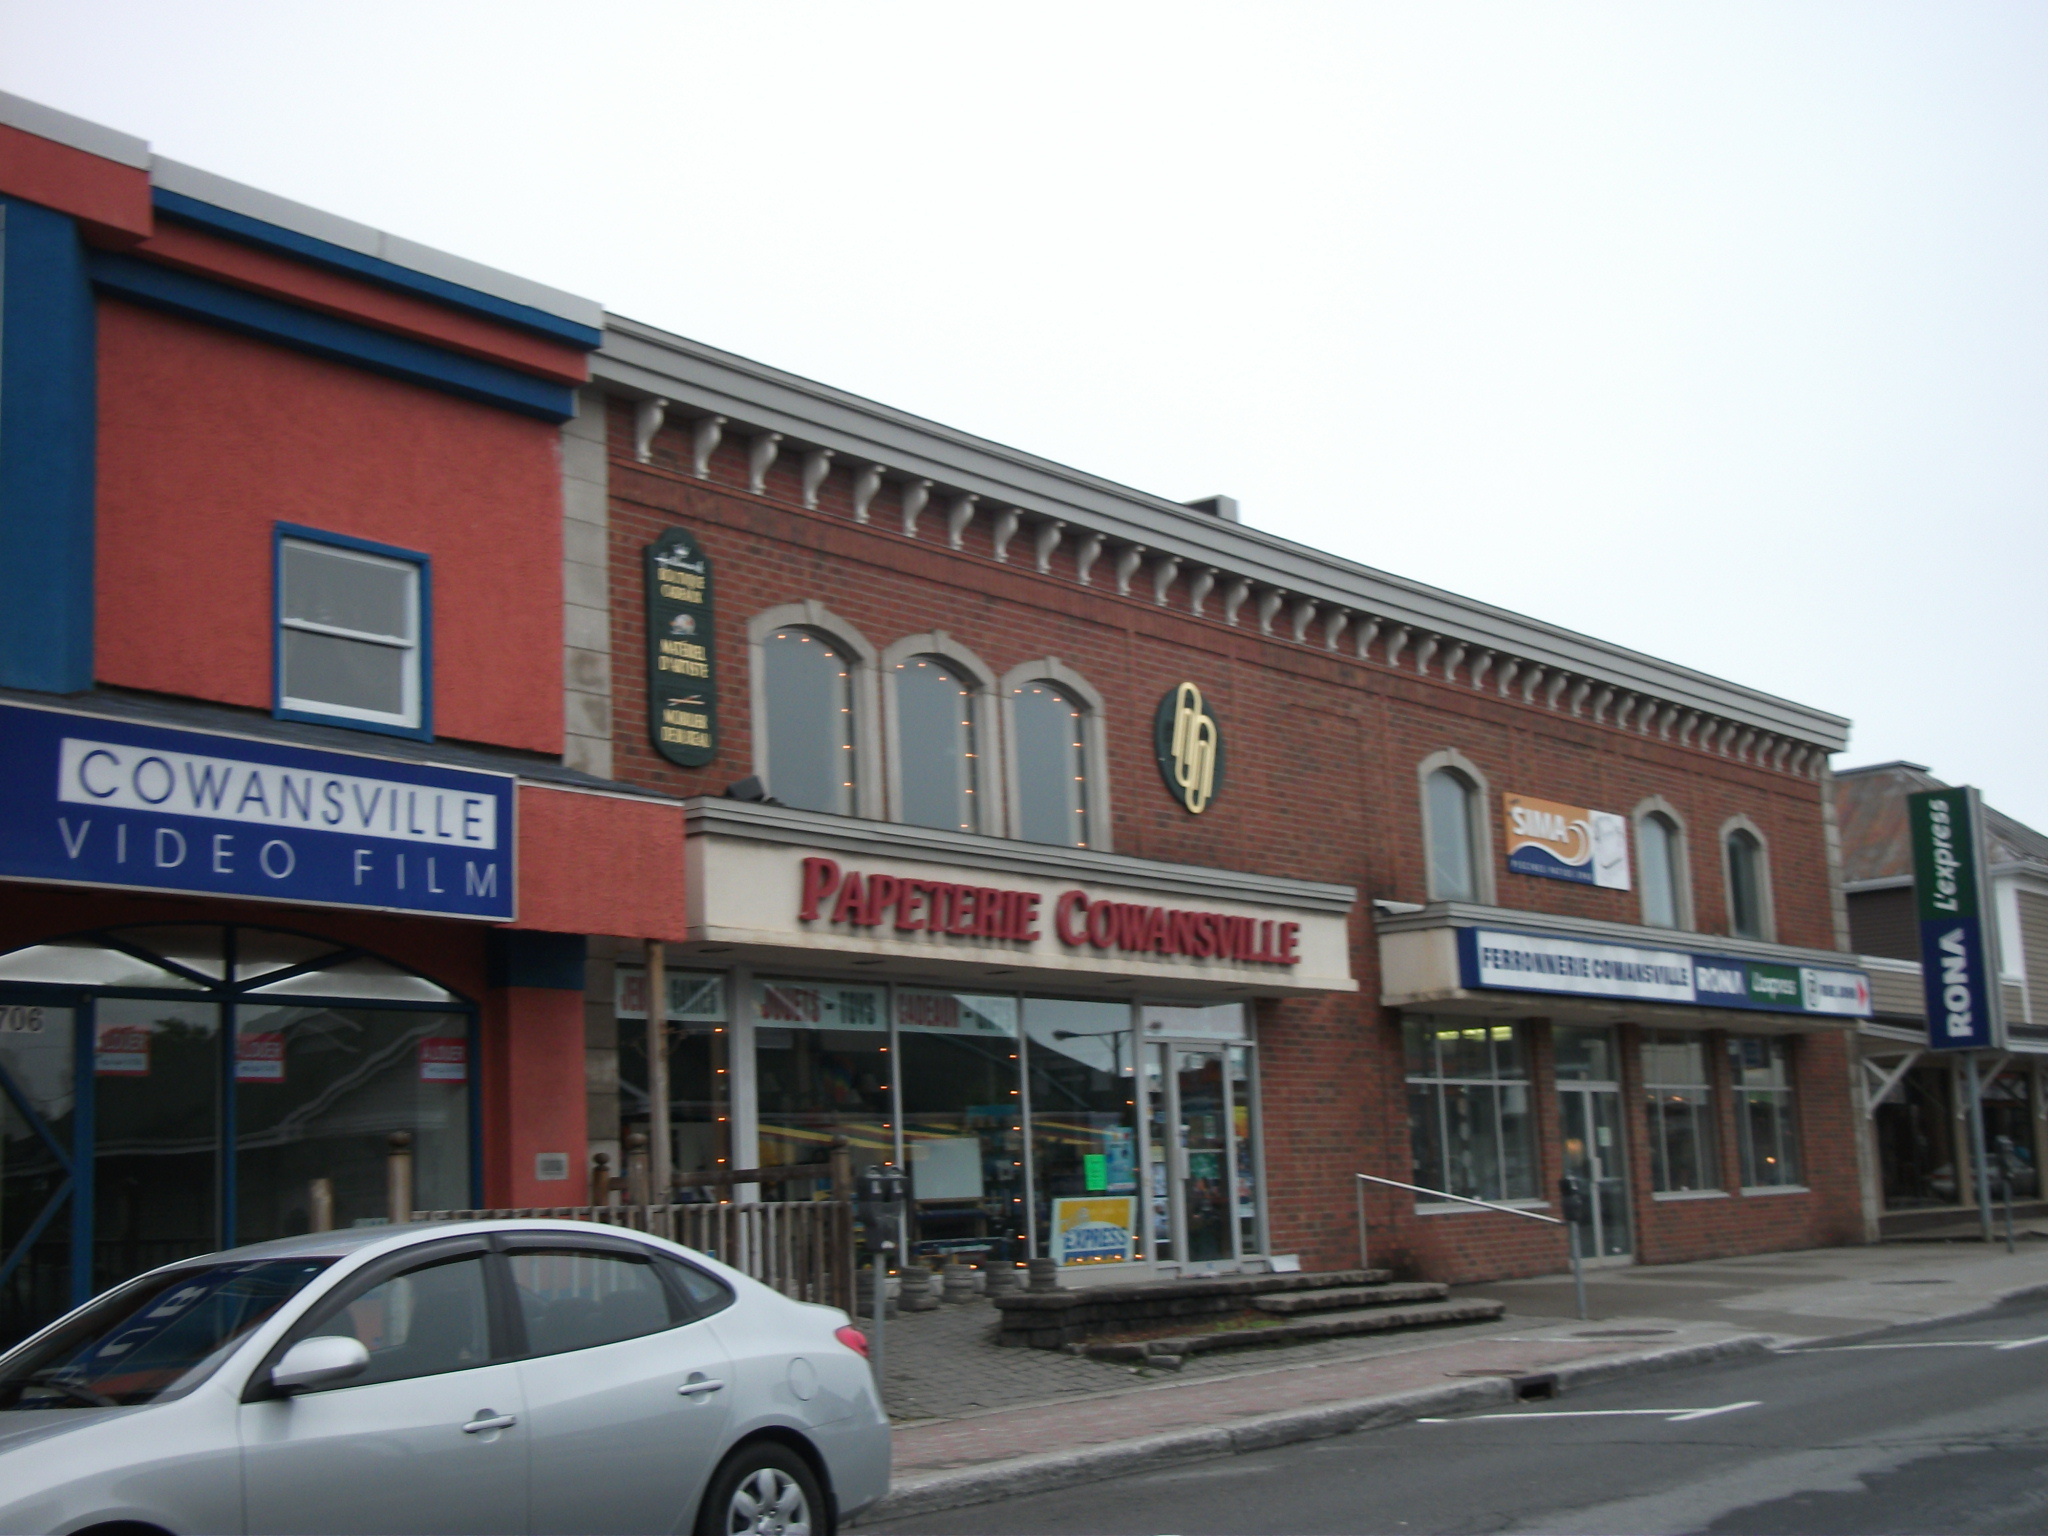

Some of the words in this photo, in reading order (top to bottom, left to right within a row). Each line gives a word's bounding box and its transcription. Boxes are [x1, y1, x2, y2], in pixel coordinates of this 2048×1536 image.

[78, 749, 483, 841] COWANSVILLE
[1511, 806, 1570, 844] SIMA
[58, 817, 297, 879] VIDEO
[353, 849, 498, 898] FILM
[1928, 799, 1962, 912] L'express
[799, 856, 1041, 942] PAPETERIE
[1055, 889, 1301, 965] COWANSVILLE
[1482, 947, 1590, 978] FERRONNERIE
[1592, 959, 1688, 986] COWANSVILLE
[1695, 966, 1747, 995] RONA
[1938, 926, 1973, 1038] RONA
[1063, 1226, 1128, 1250] EXPRESS
